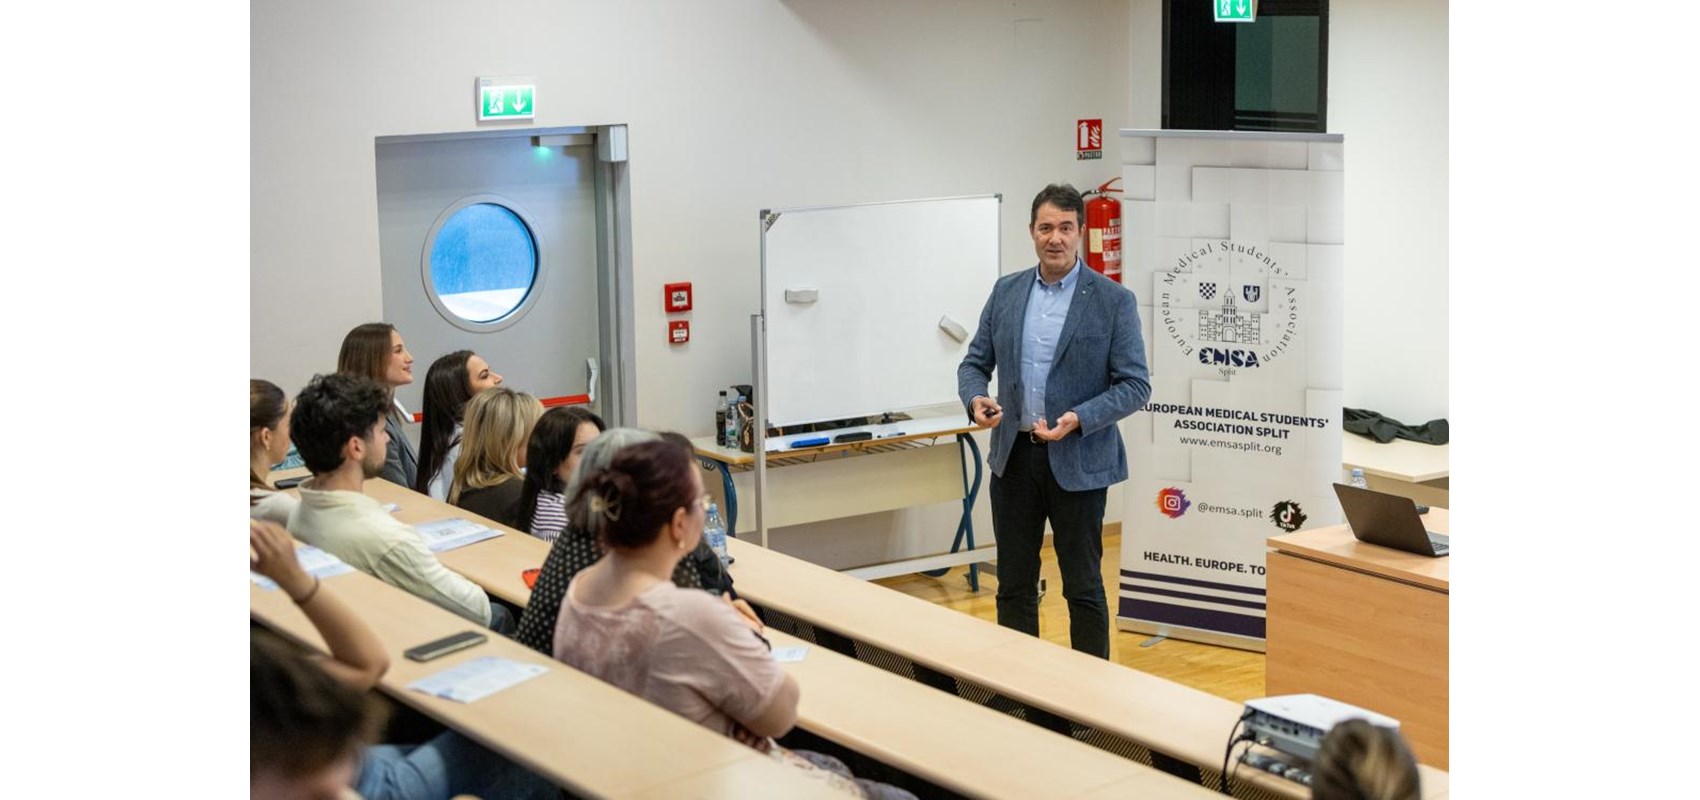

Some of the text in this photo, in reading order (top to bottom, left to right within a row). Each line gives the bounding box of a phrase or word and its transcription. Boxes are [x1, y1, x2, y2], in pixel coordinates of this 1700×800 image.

[1164, 243, 1213, 286] Medical
[1160, 292, 1194, 357] European
[1262, 286, 1297, 363] Association
[1198, 347, 1260, 368] EMSA
[1218, 367, 1236, 377] Split
[1205, 408, 1258, 422] MEDICAL
[1260, 412, 1329, 428] STUDENTS'
[1174, 419, 1290, 439] ASSOCIATION SPLIT
[1179, 436, 1282, 455] www.emsasplit.org
[1197, 502, 1264, 519] @emsa.split
[1144, 551, 1193, 566] HEALTH.
[1195, 557, 1247, 573] EUROPE.
